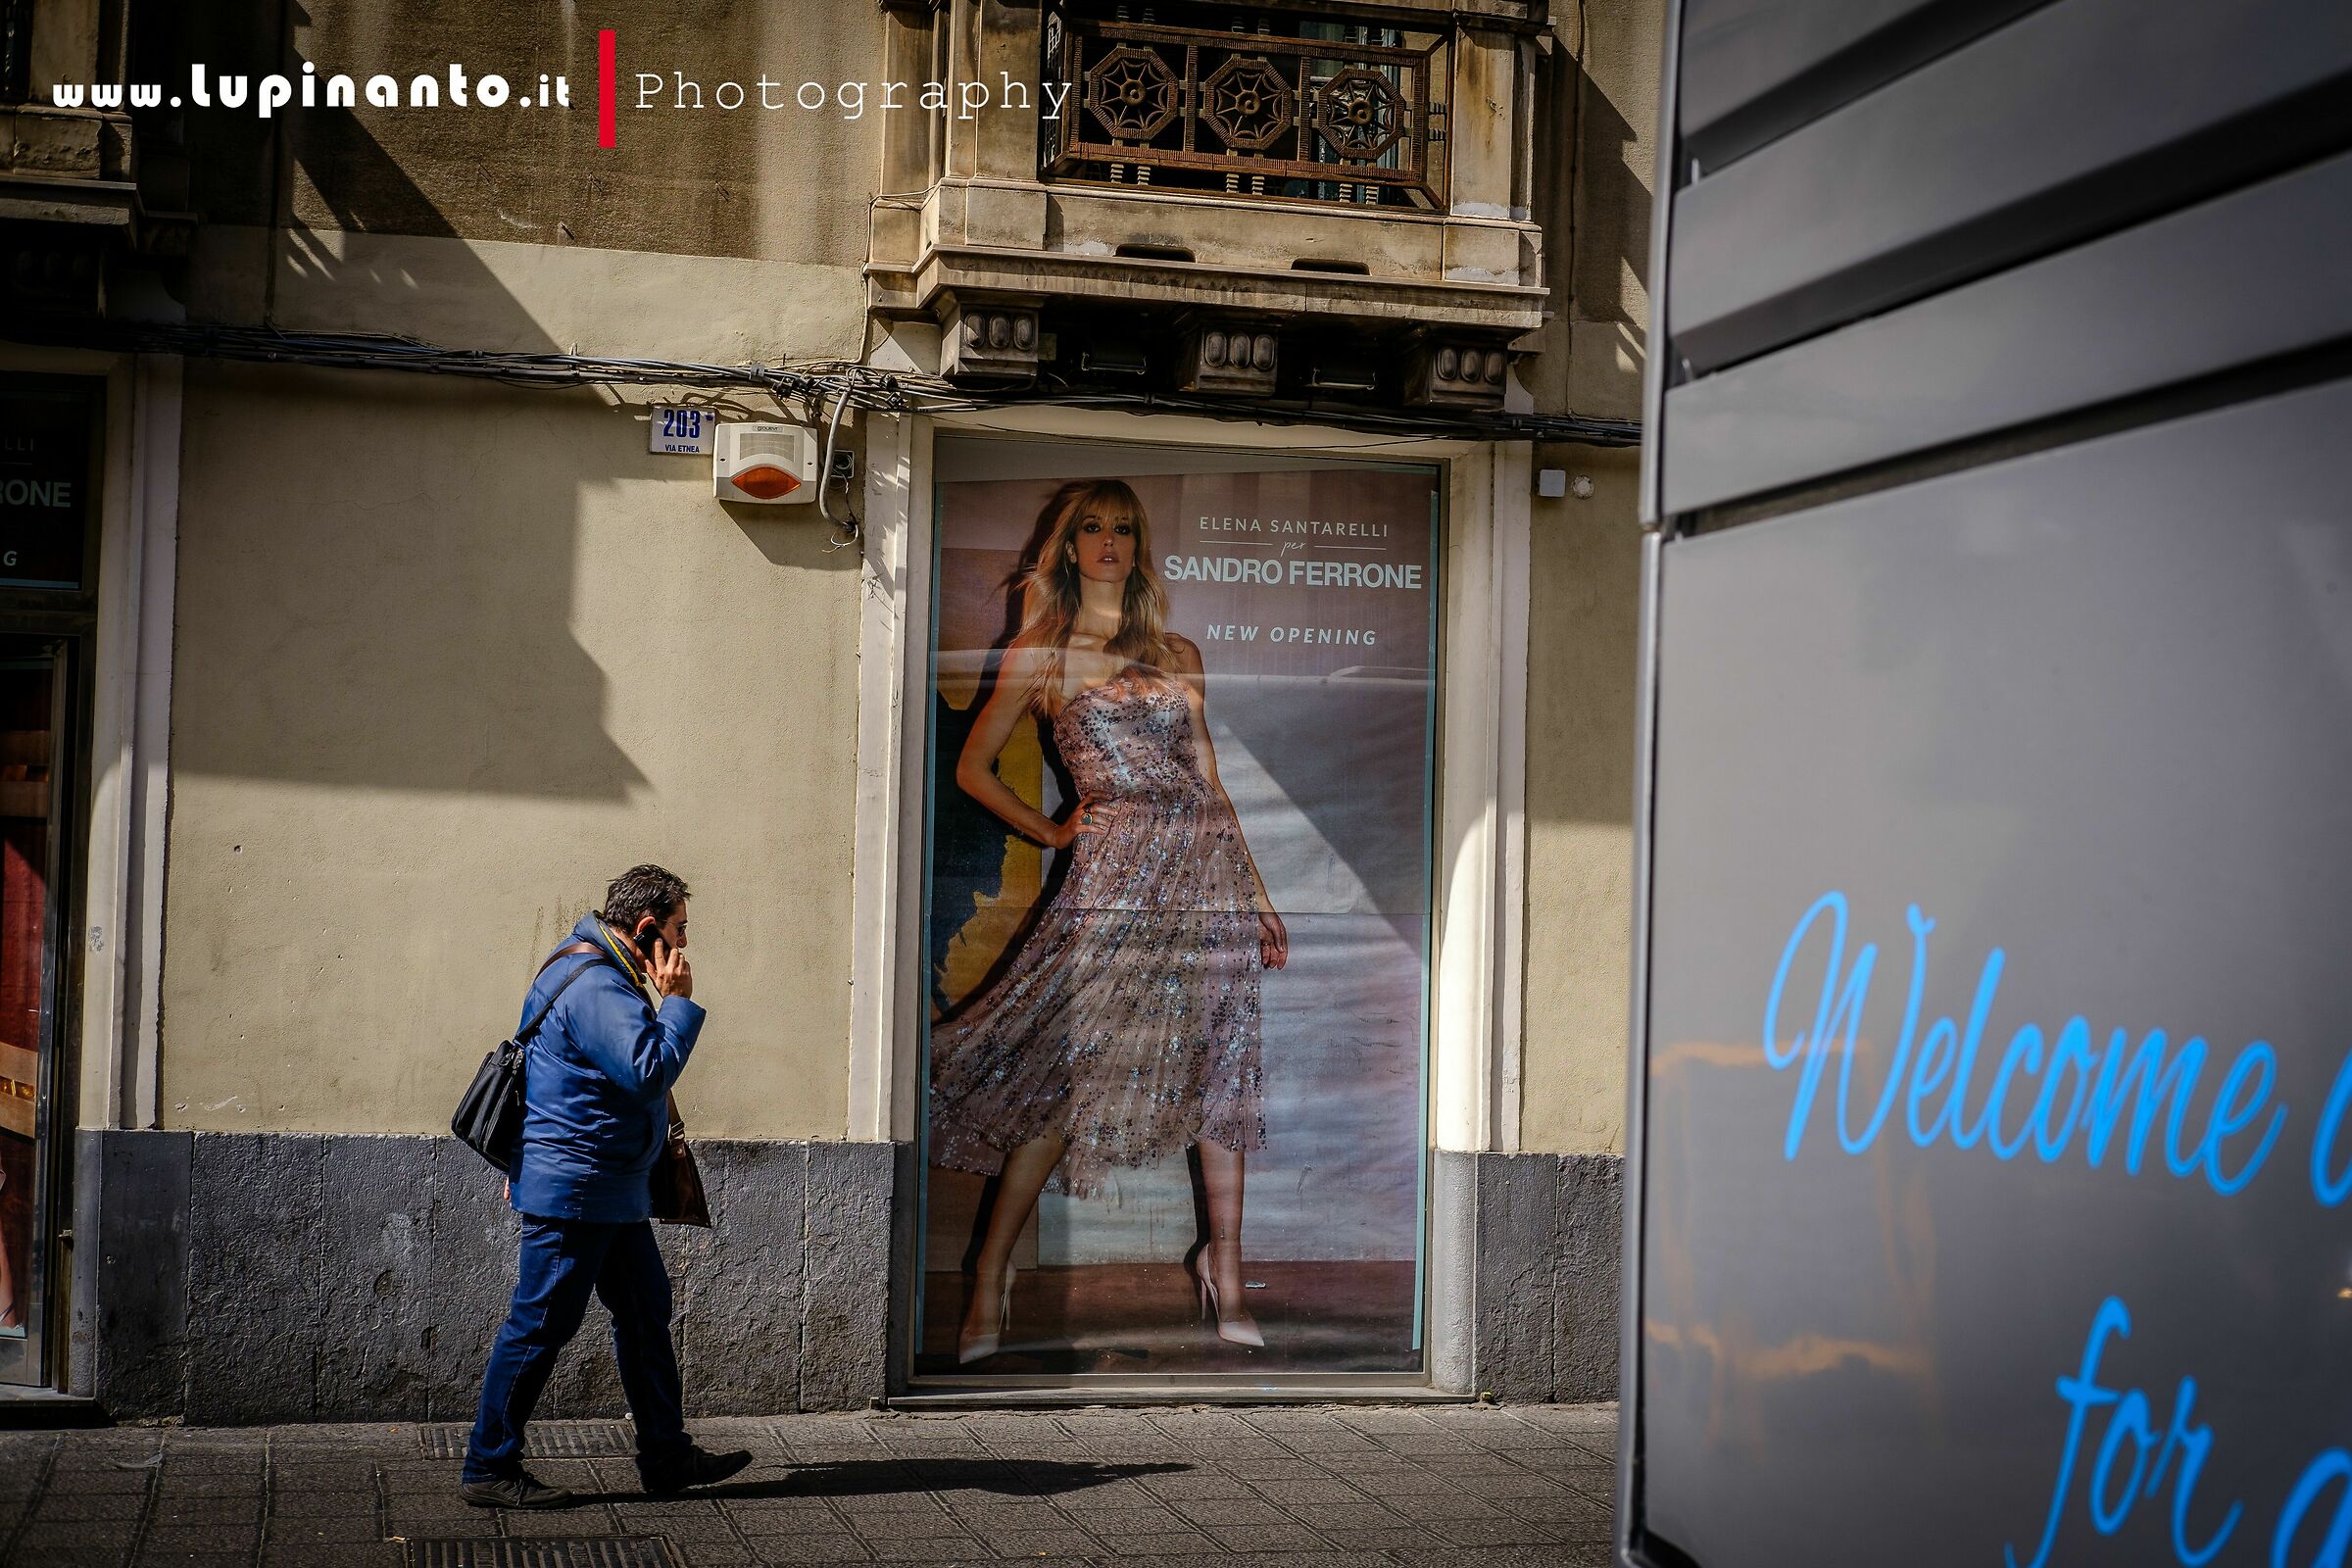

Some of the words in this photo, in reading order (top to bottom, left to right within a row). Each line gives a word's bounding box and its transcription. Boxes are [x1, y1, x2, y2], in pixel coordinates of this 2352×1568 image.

[662, 409, 701, 439] 203
[0, 478, 72, 508] ONE
[1200, 516, 1262, 532] ELENA
[1270, 519, 1389, 537] SANTARELLI
[1280, 540, 1305, 557] per
[1164, 555, 1284, 585] SANDRO
[1289, 561, 1422, 589] FERRONE
[1206, 624, 1259, 642] NEW
[1270, 626, 1377, 646] OPENING
[1763, 890, 2288, 1197] Welcome
[2004, 1295, 2243, 1568] for
